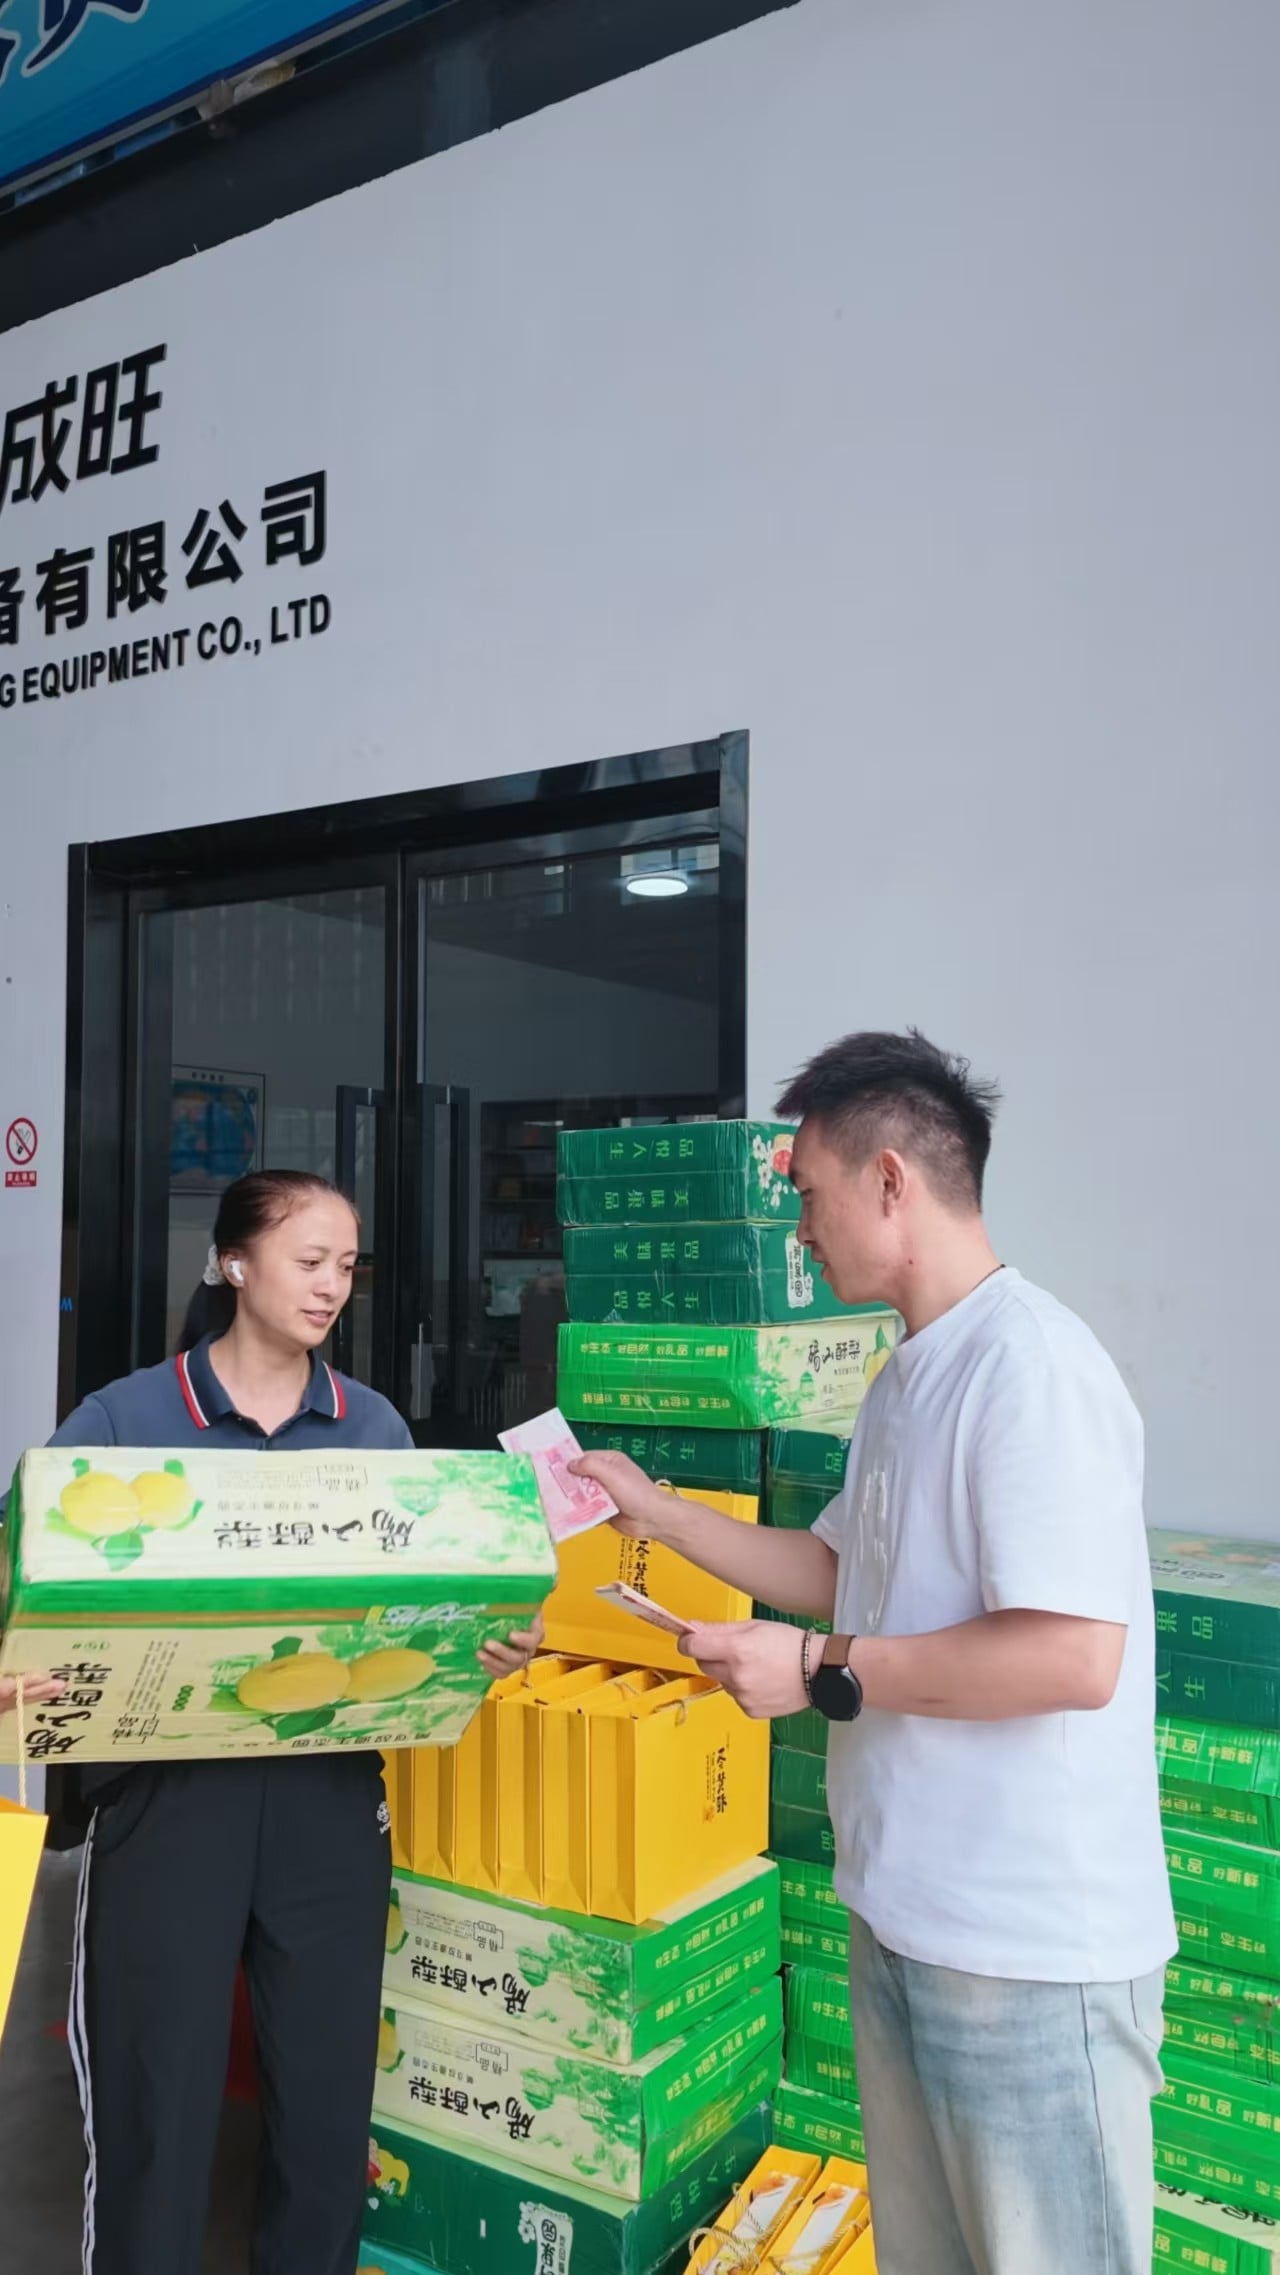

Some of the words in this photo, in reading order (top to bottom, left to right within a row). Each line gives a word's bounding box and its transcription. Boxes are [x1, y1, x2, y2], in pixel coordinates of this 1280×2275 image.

[0, 343, 167, 514] 成旺
[22, 628, 190, 703] EQUIPMENT
[197, 615, 261, 660] CO.,
[271, 593, 331, 644] LTD
[213, 1509, 416, 1553] 砀山酥梨
[410, 1955, 530, 2015] 砀山酥梨
[408, 2075, 535, 2139] 砀山酥梨
